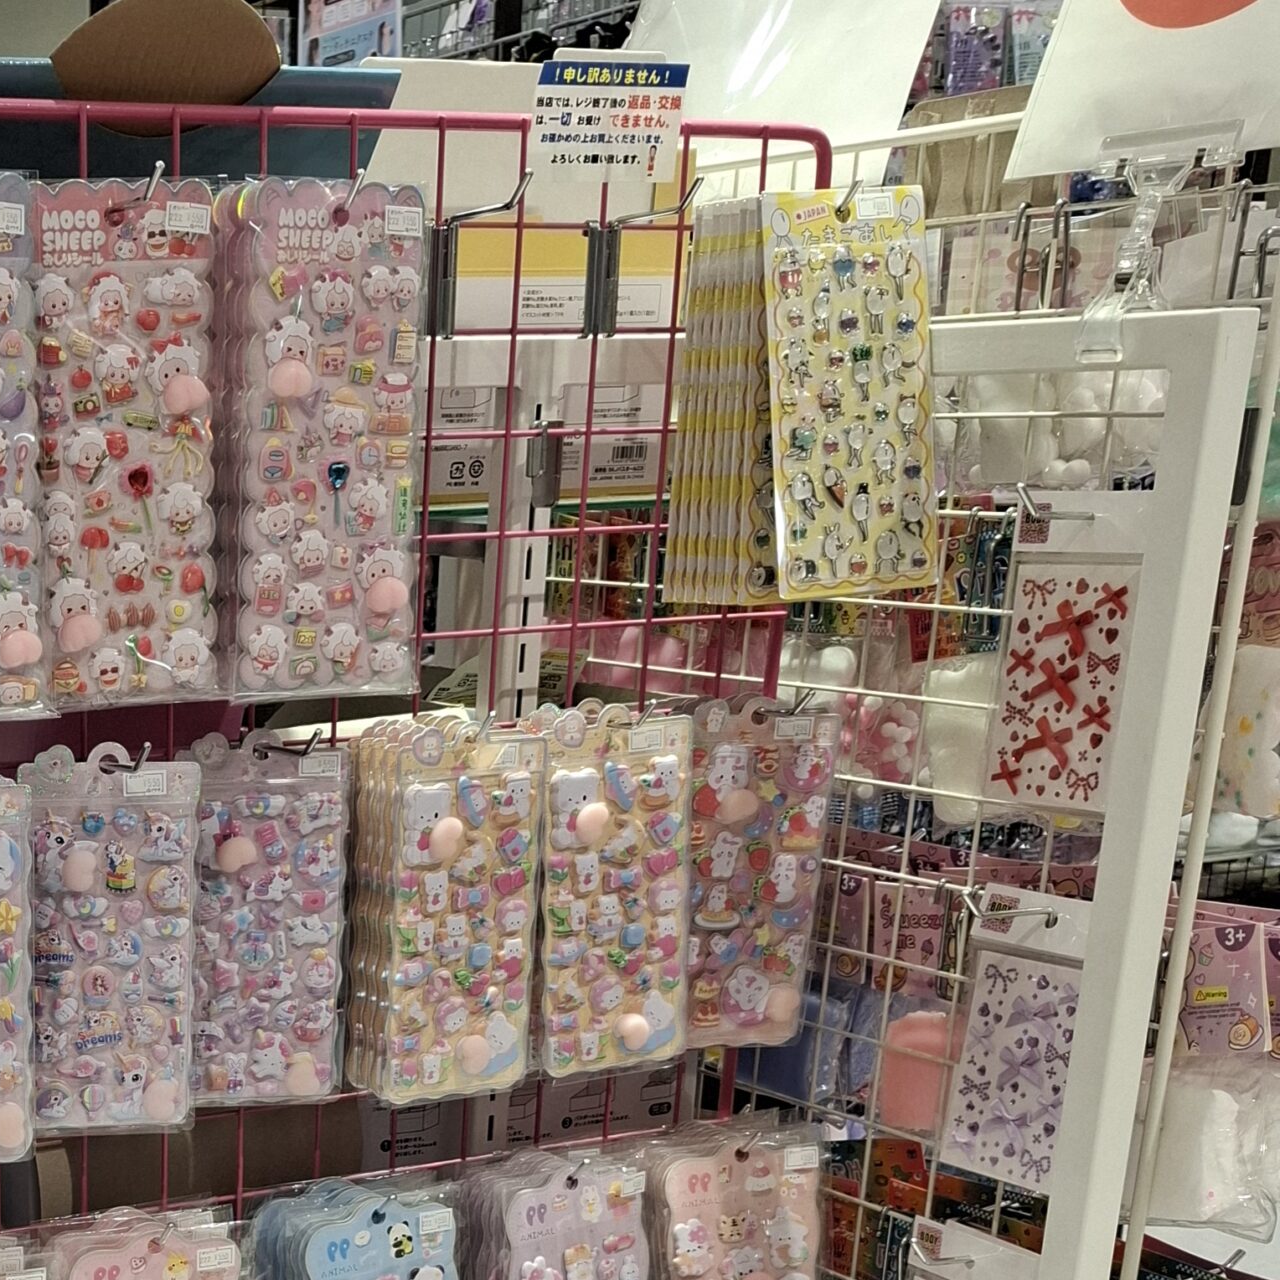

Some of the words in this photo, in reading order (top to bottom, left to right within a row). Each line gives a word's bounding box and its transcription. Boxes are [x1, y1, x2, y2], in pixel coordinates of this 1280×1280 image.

[41, 209, 101, 231] MOCO
[278, 207, 330, 229] MOCO
[803, 206, 827, 220] JAPAN
[42, 230, 107, 252] SHEEP
[276, 228, 335, 249] SHEEP
[801, 223, 893, 247] たまごあし
[41, 252, 104, 267] おしりシール
[841, 873, 857, 890] 3+
[1224, 927, 1246, 946] 3+
[321, 1264, 358, 1278] ANIMAL
